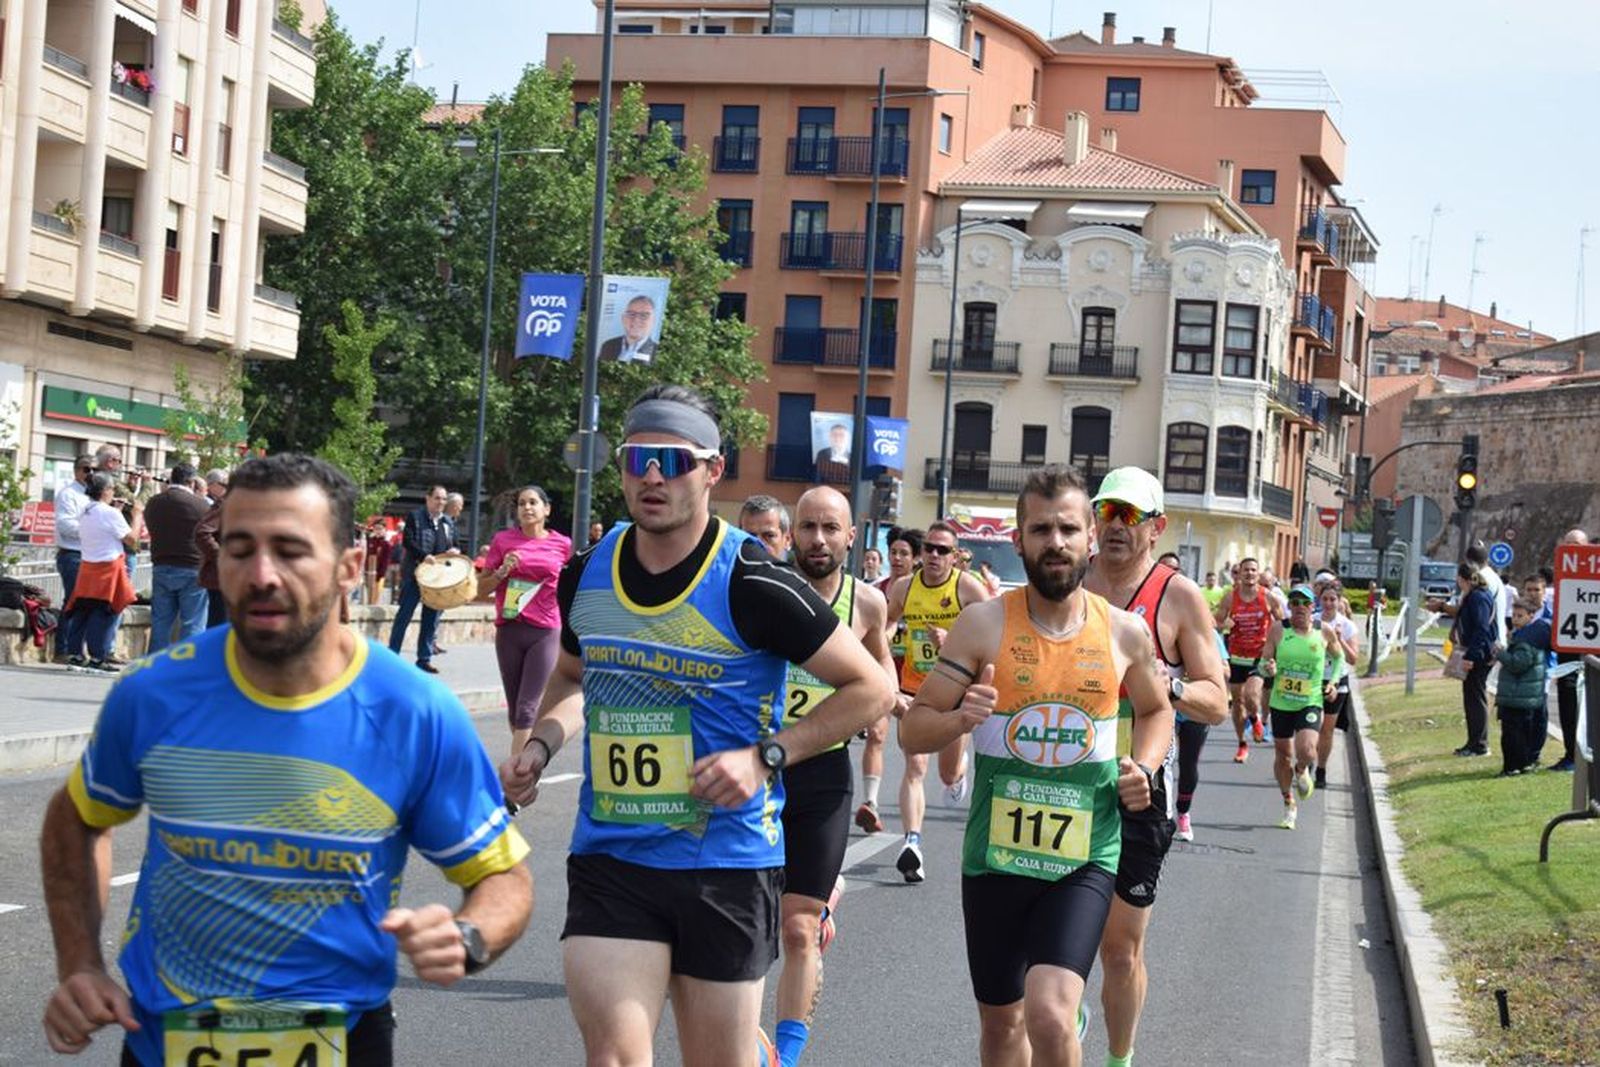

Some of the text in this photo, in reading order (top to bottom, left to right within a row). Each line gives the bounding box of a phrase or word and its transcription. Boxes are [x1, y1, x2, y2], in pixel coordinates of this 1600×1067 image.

[530, 295, 567, 308] VOTA
[874, 429, 900, 440] VOTA
[1562, 553, 1600, 574] N-1
[659, 653, 724, 680] DUERO
[1284, 679, 1302, 692] 34
[636, 723, 674, 734] RURAL
[1014, 725, 1088, 748] ALCER
[609, 743, 661, 787] 66
[615, 802, 689, 814] CAJA RURAL
[1049, 795, 1082, 808] RURAL
[1007, 807, 1073, 850] 117
[279, 840, 371, 874] DUERO
[1015, 857, 1040, 870] CAJA
